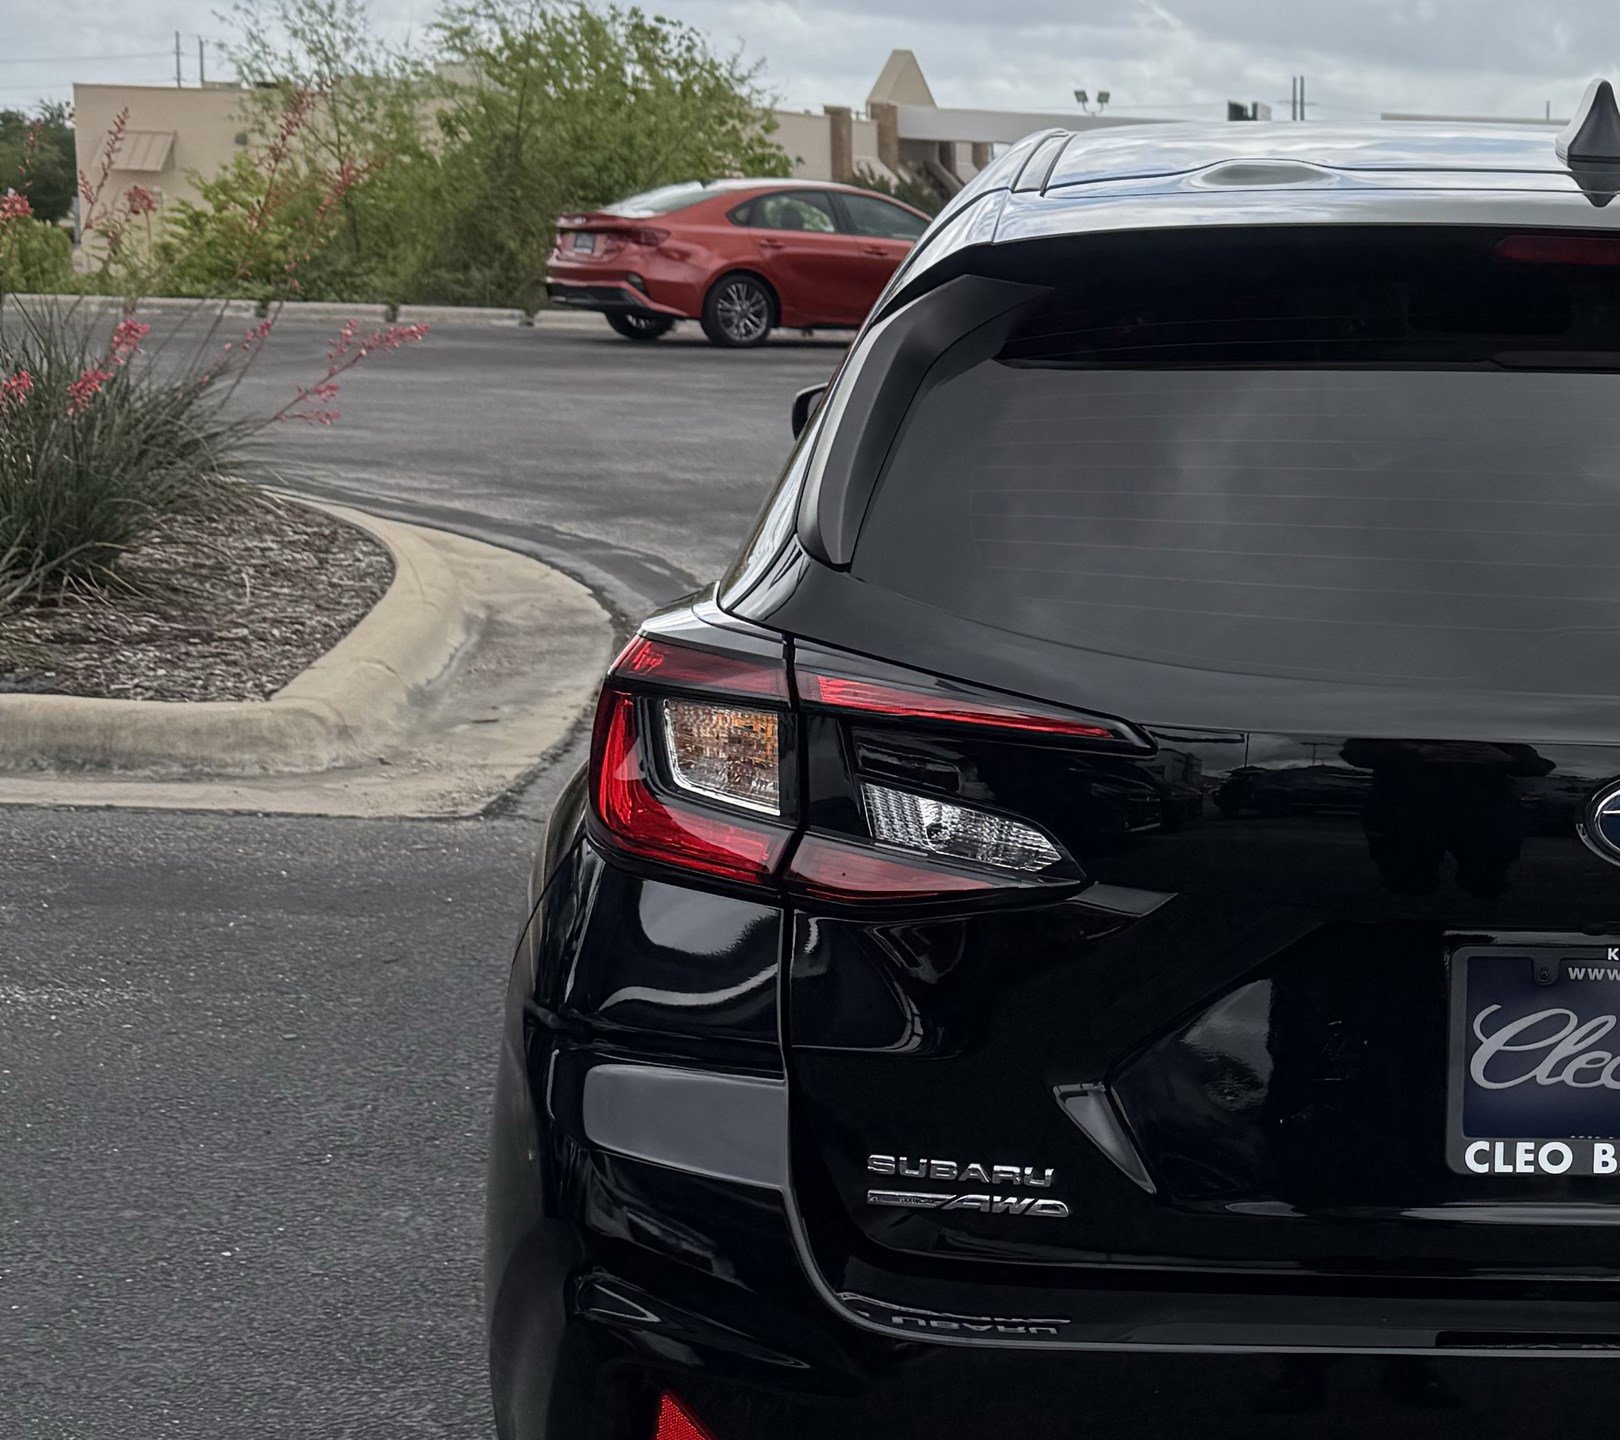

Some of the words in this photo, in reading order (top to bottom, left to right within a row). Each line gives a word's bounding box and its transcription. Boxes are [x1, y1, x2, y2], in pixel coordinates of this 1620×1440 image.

[867, 1154, 1054, 1187] SUBARU
[1464, 1141, 1573, 1174] CLEO
[942, 1194, 1069, 1217] AWD
